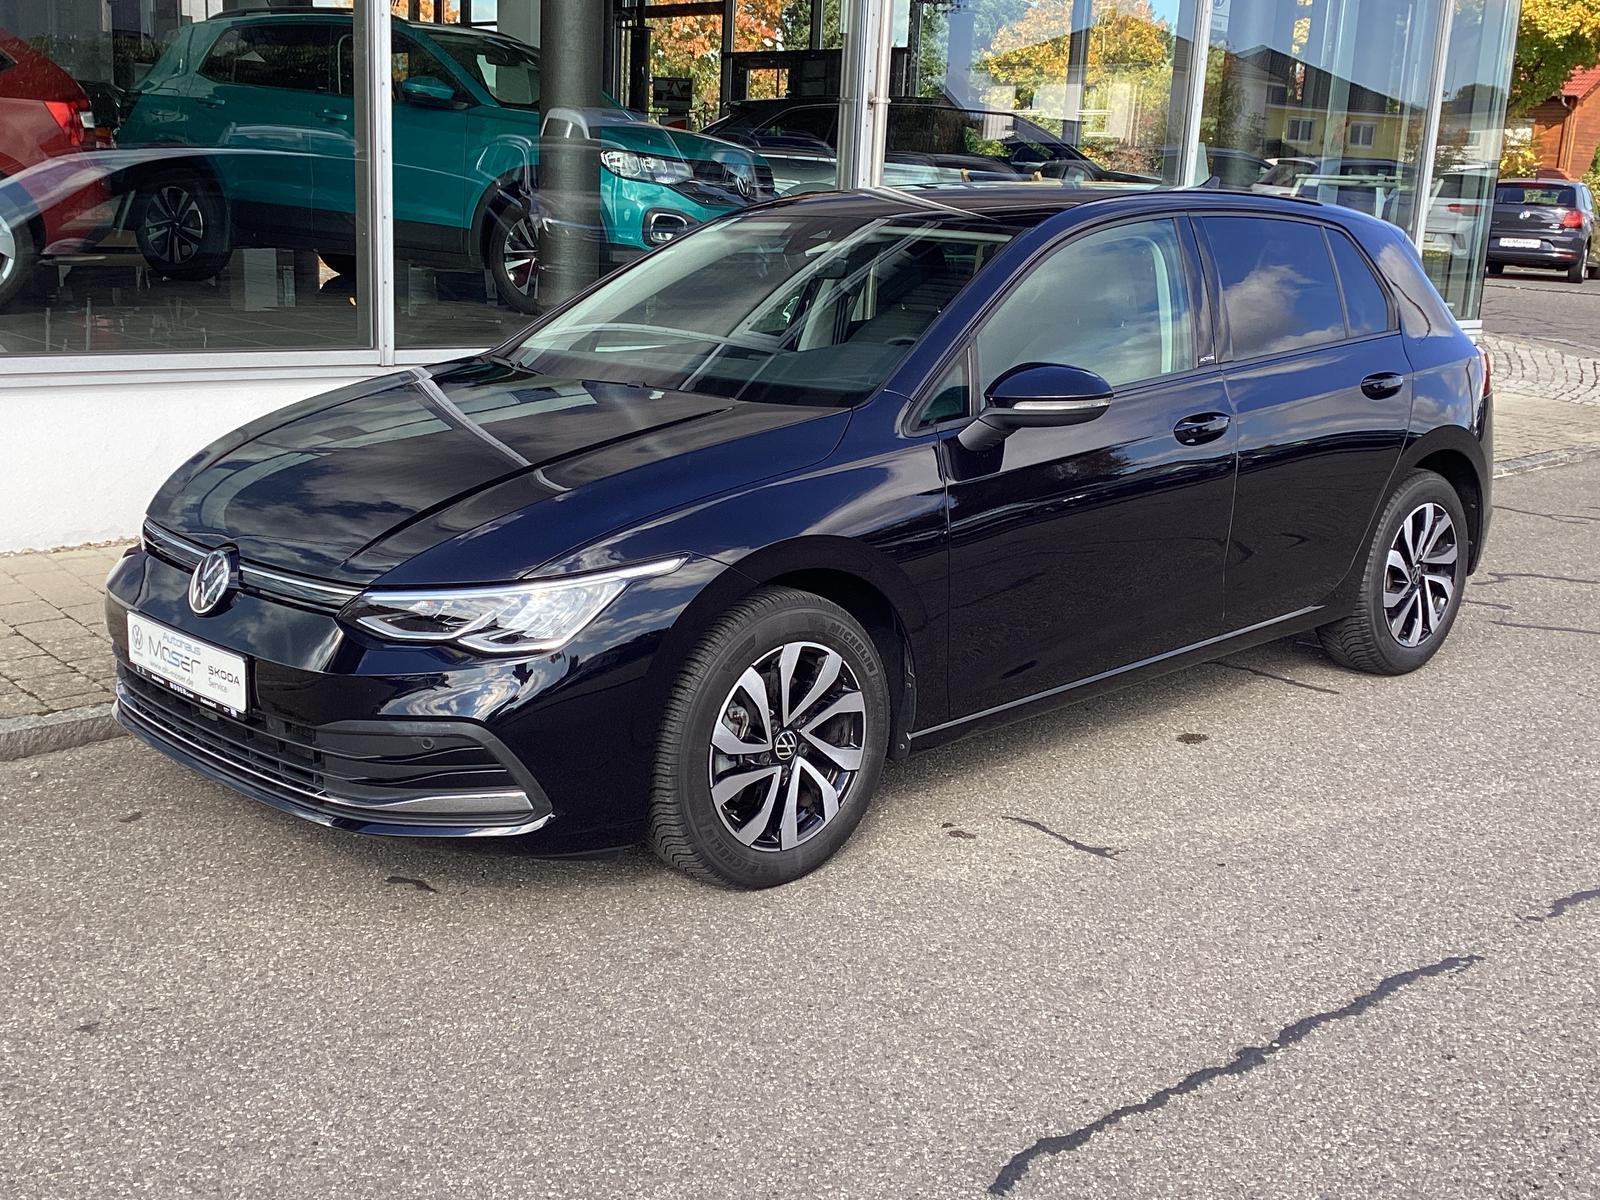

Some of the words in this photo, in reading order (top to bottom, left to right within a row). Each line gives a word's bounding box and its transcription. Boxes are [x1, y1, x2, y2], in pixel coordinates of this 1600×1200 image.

[148, 635, 201, 674] Moser
[162, 632, 201, 656] Autohaus
[827, 621, 877, 674] MICHELIN
[208, 677, 228, 693] Service
